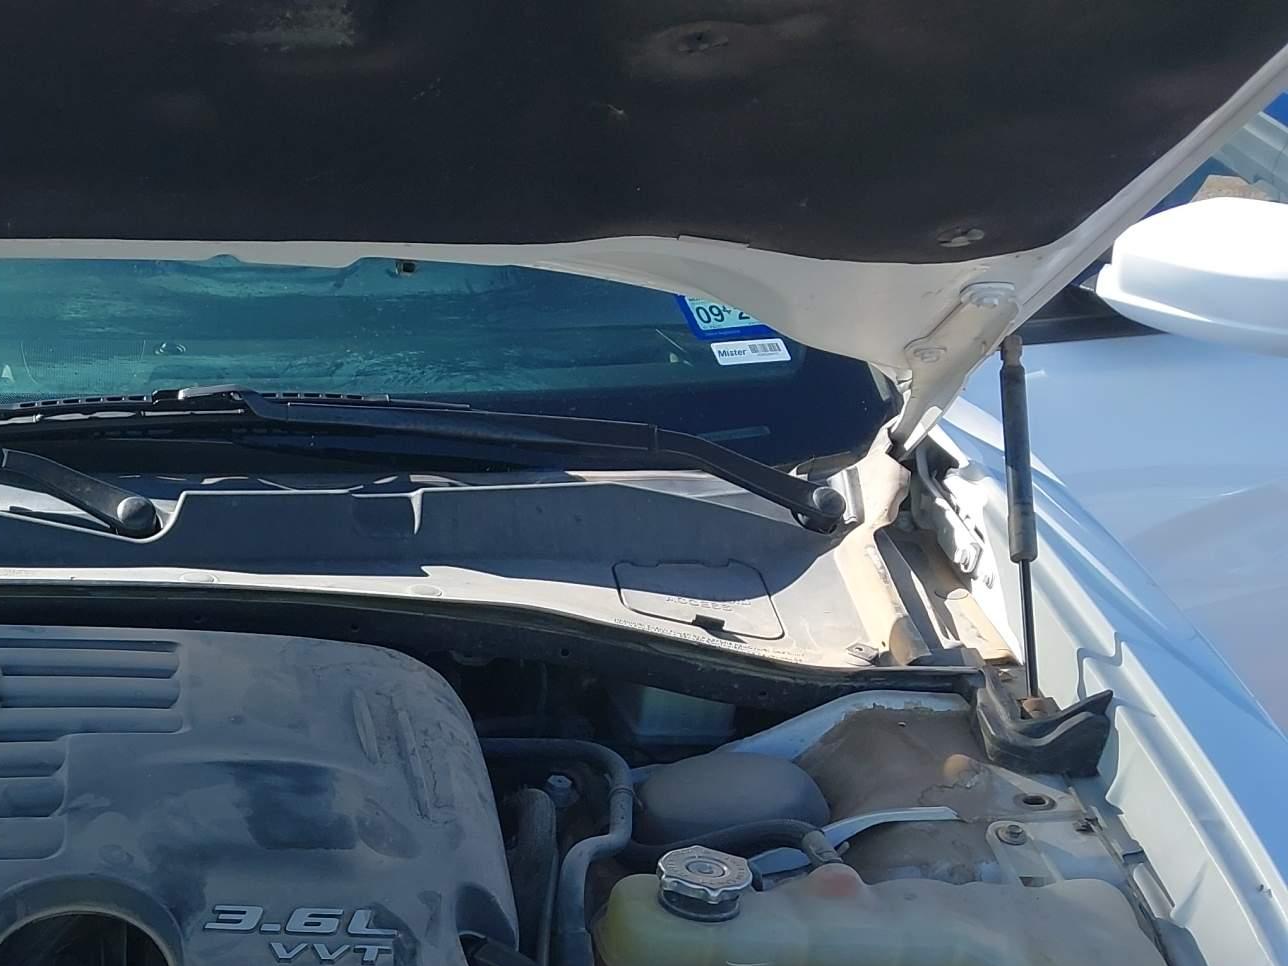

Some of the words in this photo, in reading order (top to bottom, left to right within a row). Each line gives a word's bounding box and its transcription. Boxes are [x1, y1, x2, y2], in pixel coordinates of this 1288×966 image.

[695, 304, 725, 324] 09
[718, 348, 747, 358] Mister
[203, 904, 400, 936] 3.6L
[270, 942, 394, 966] VVT
